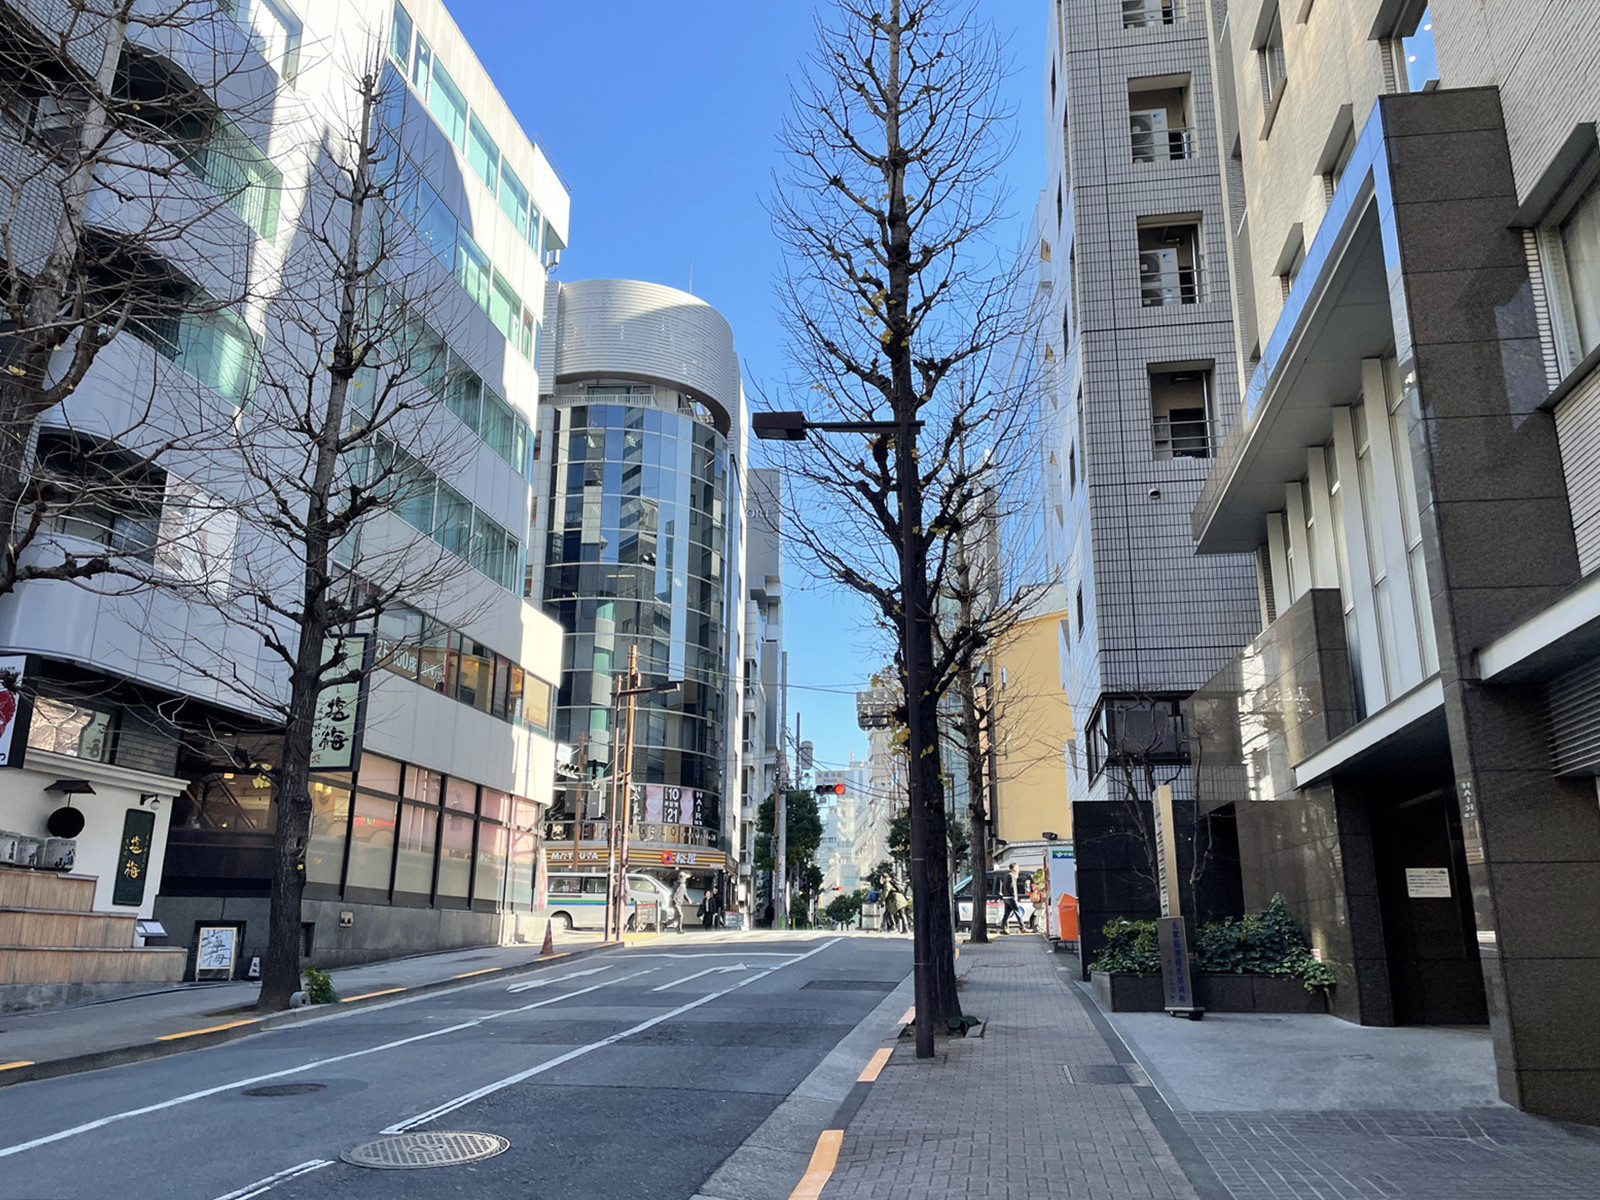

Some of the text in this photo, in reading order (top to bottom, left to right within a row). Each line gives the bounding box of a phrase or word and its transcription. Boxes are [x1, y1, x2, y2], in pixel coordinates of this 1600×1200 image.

[668, 787, 679, 800] 10
[695, 791, 703, 820] HAIR
[667, 808, 678, 823] 21
[551, 852, 598, 860] MATUYA
